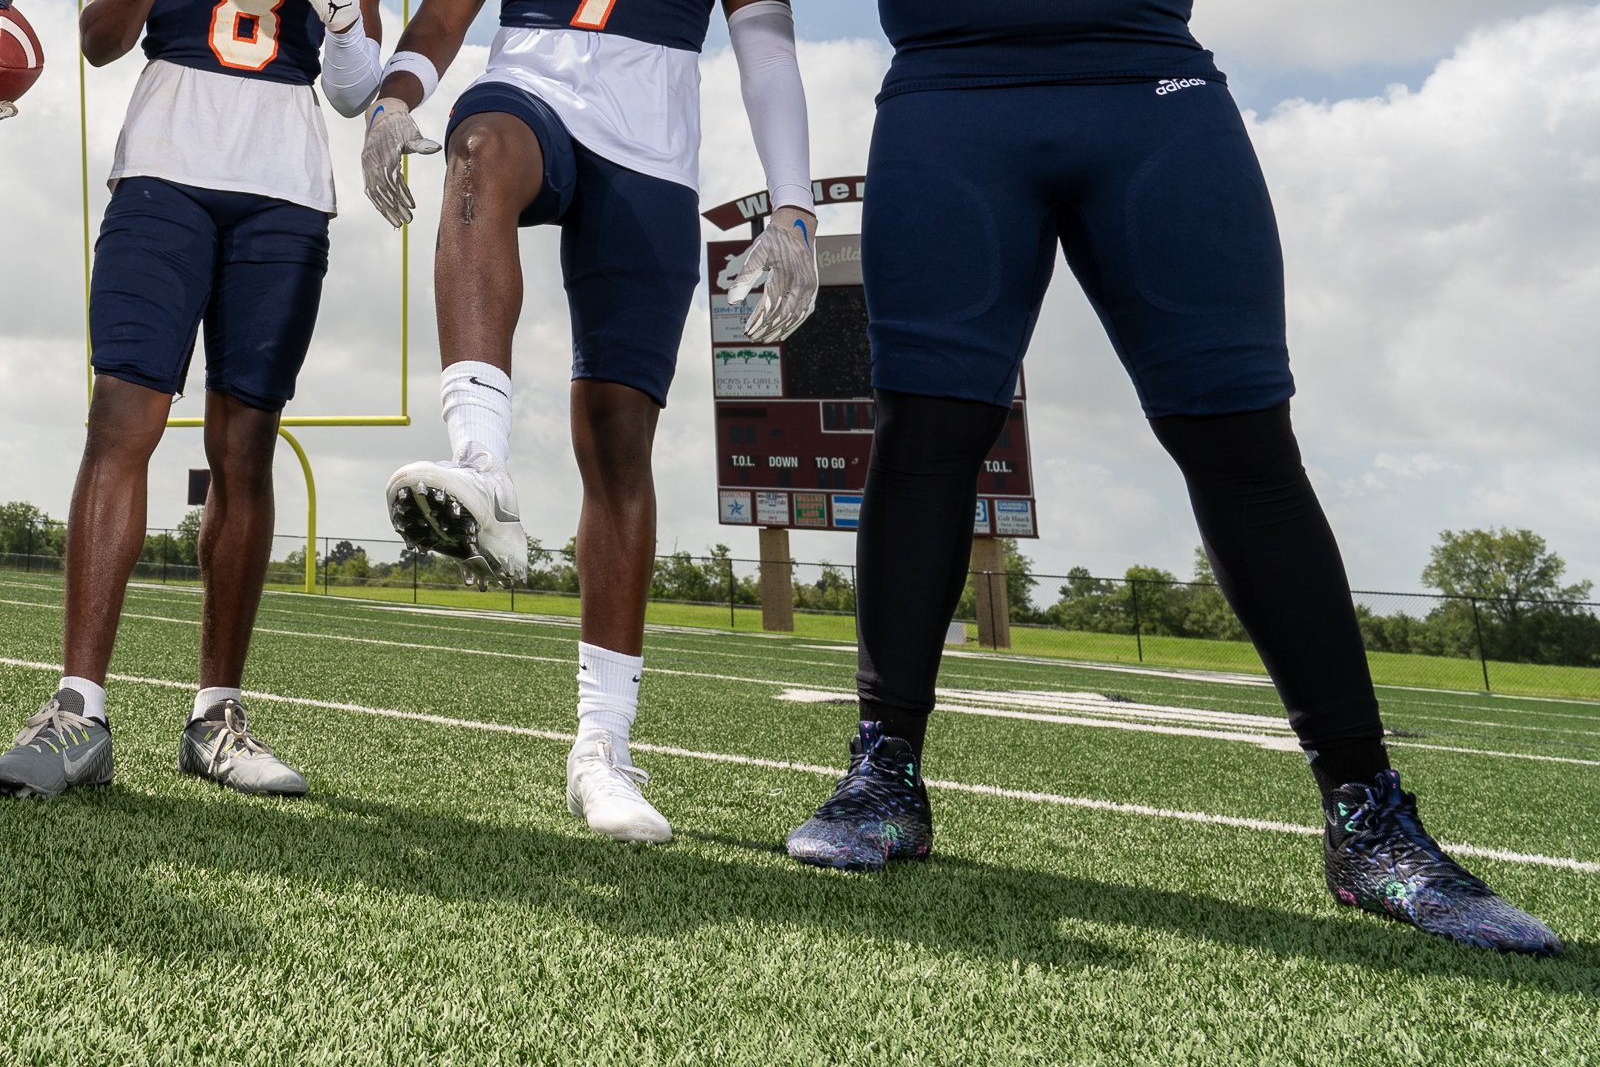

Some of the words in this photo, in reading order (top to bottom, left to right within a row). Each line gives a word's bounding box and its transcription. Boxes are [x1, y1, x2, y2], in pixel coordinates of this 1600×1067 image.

[1155, 78, 1207, 95] adidas
[817, 245, 862, 269] Bulld
[716, 377, 741, 385] BOYS
[752, 377, 780, 386] GIRLS
[732, 455, 755, 467] T.O.L.
[768, 456, 799, 468] DOWN
[815, 457, 829, 469] TO
[831, 457, 845, 469] GO
[984, 460, 1012, 473] T.O.L.
